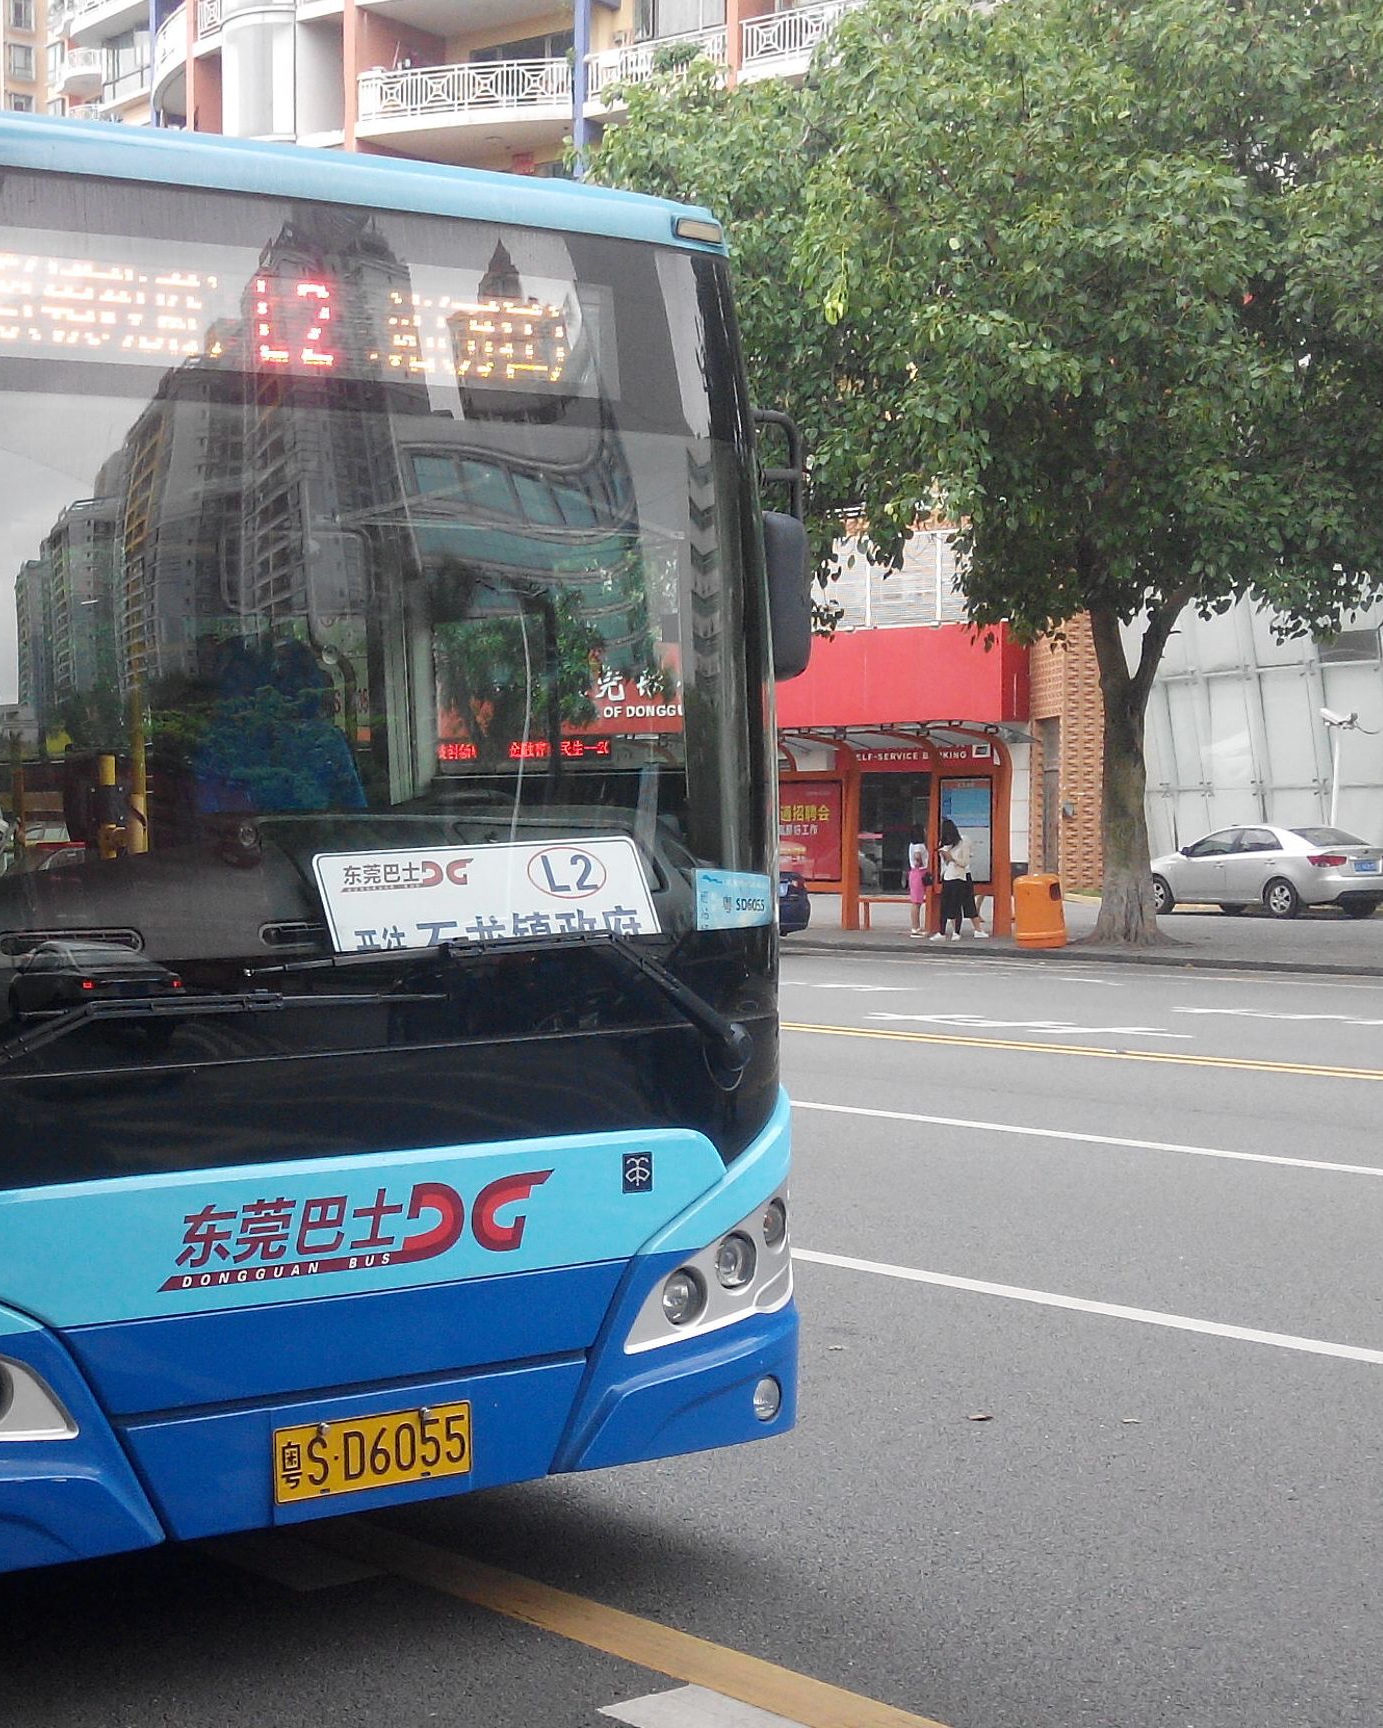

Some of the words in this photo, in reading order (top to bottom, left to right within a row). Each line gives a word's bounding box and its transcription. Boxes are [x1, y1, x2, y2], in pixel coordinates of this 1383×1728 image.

[256, 278, 335, 367] L2
[603, 704, 623, 718] OF
[343, 862, 421, 886] 东莞巴士
[539, 854, 599, 893] L2
[175, 1188, 404, 1268] 东莞巴士
[182, 1262, 320, 1289] DONGGUAN
[348, 1252, 392, 1270] BUS
